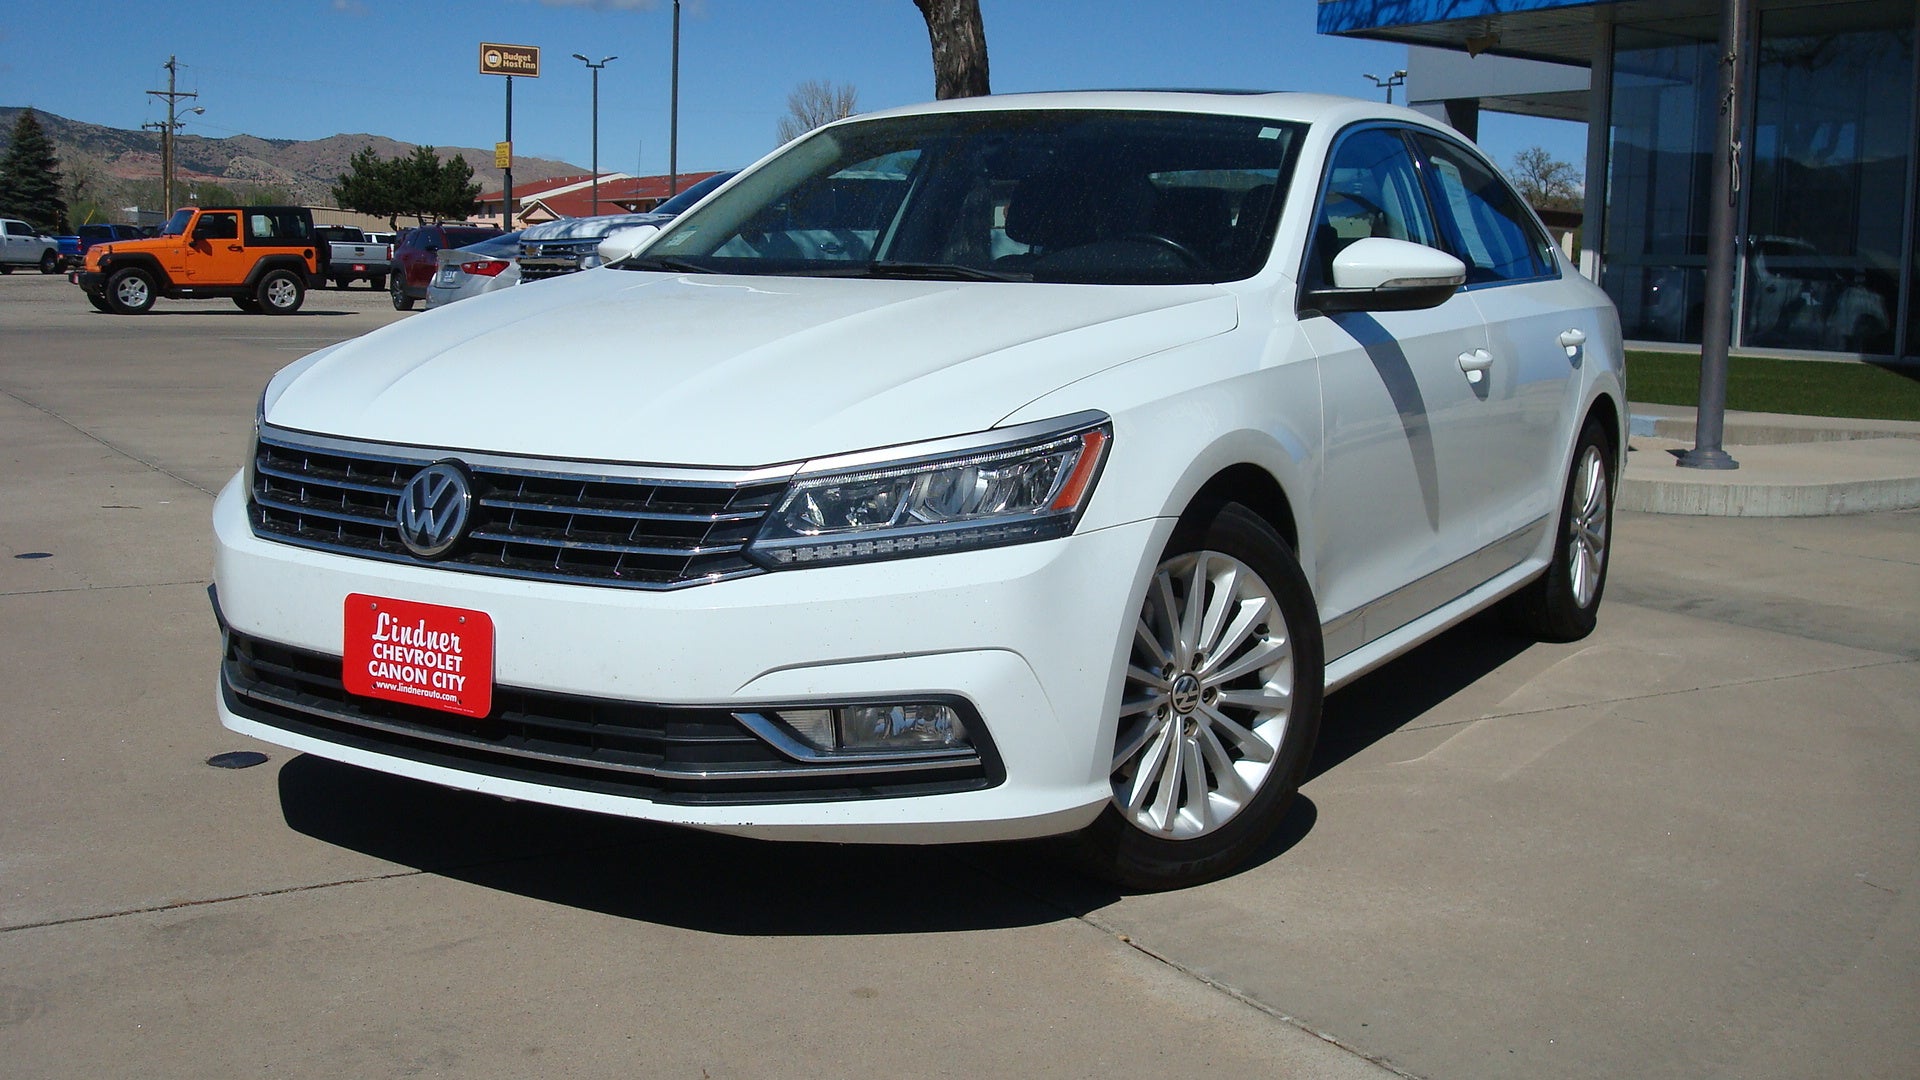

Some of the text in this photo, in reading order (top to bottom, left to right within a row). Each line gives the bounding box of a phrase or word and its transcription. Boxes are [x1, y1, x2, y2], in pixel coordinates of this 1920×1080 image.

[503, 52, 531, 62] Budget
[503, 60, 536, 69] Host Inn
[372, 612, 462, 653] Lindner
[373, 643, 463, 672] CHEVROLET
[368, 661, 466, 692] CANON CITY
[376, 682, 457, 702] www.lindnerauto.com
